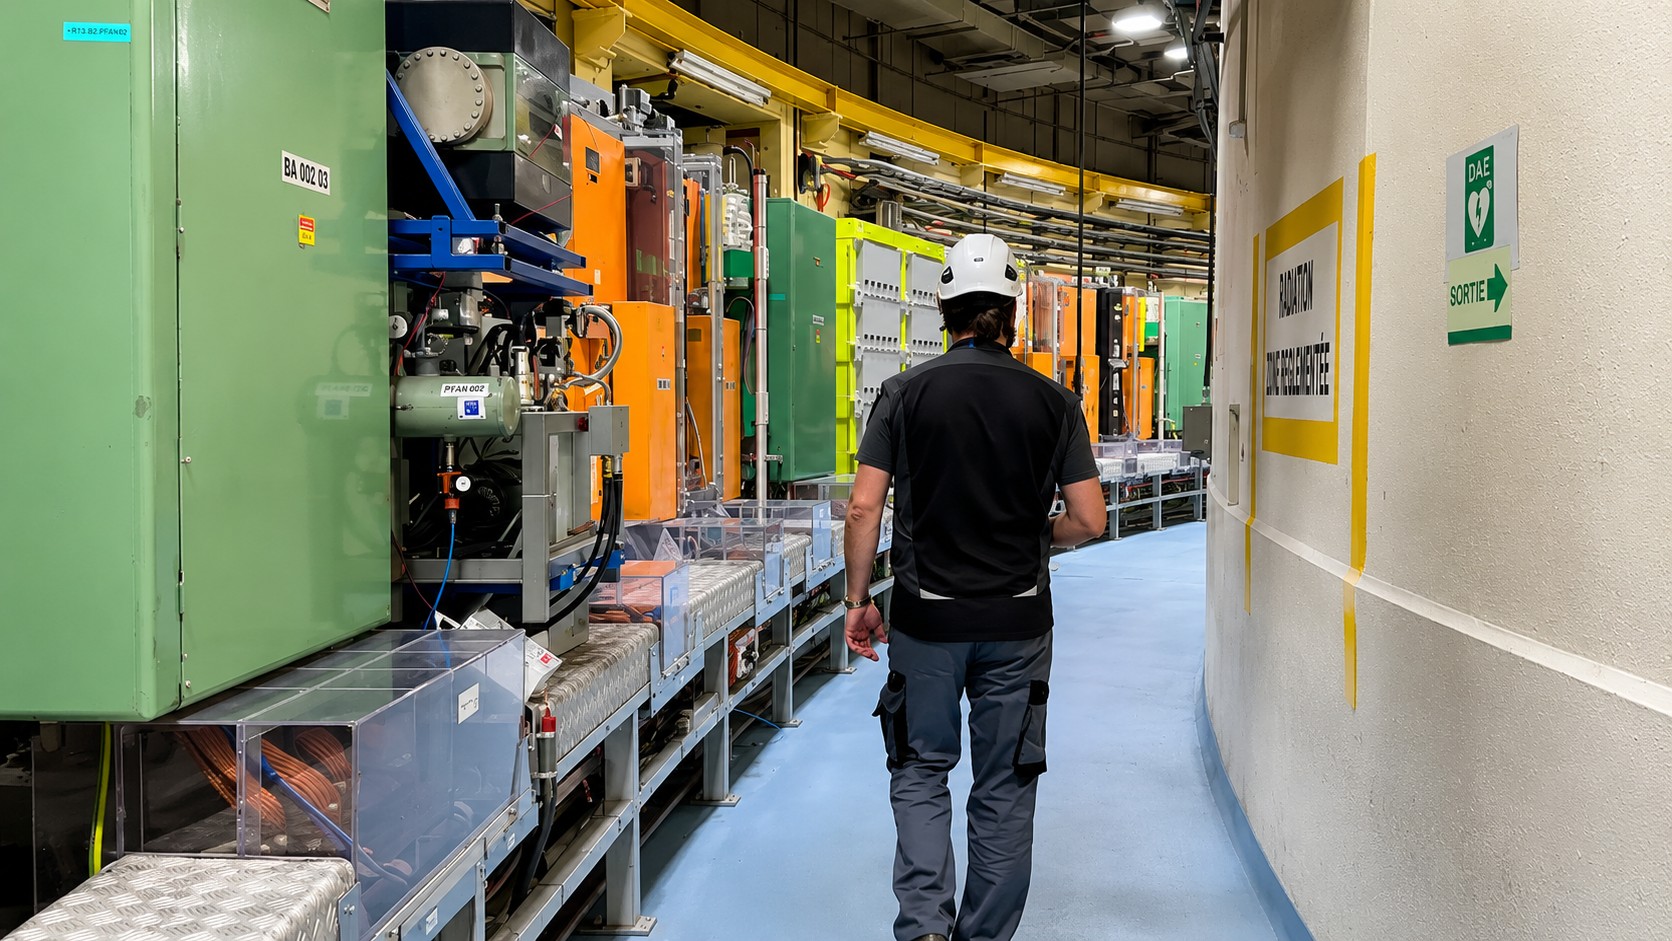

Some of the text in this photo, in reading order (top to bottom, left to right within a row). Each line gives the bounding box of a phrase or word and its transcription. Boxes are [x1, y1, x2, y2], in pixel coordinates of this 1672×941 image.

[284, 156, 329, 190] BA 002 03
[1468, 155, 1491, 183] DAE
[1278, 259, 1314, 320] RADIATION
[1450, 279, 1486, 307] SORTIE
[443, 384, 485, 393] PFAN 002
